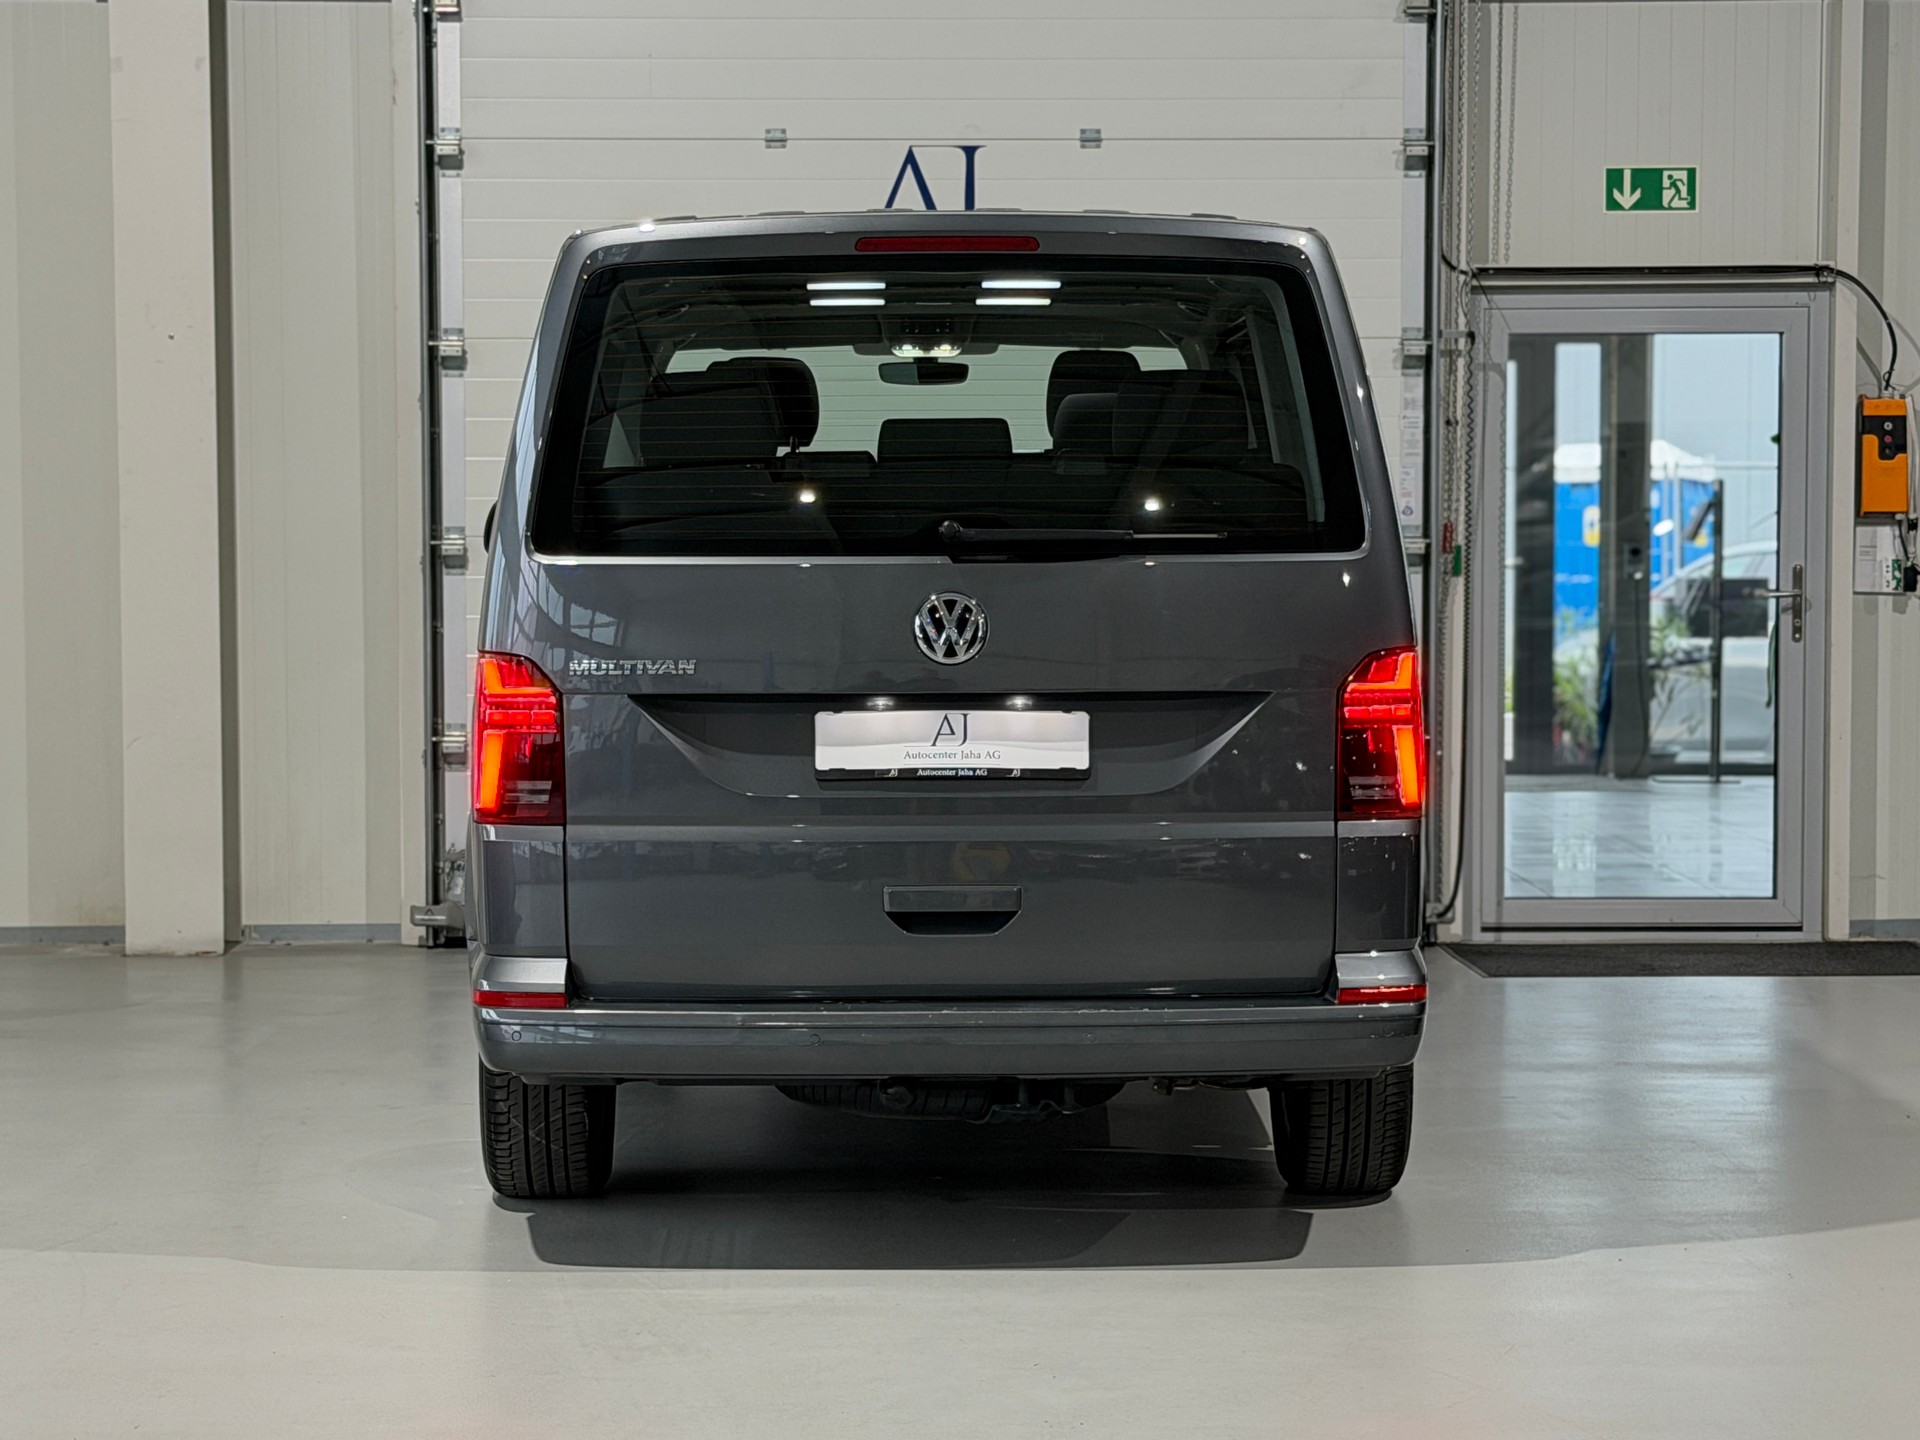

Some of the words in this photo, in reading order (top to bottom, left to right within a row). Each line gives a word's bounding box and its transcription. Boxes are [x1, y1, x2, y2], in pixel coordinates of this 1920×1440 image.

[569, 659, 697, 676] MULTIVAN
[930, 713, 970, 747] AJ
[904, 750, 957, 760] Autocenter
[960, 750, 982, 760] Jaha
[984, 750, 1001, 760] AG
[958, 769, 973, 777] Jaha
